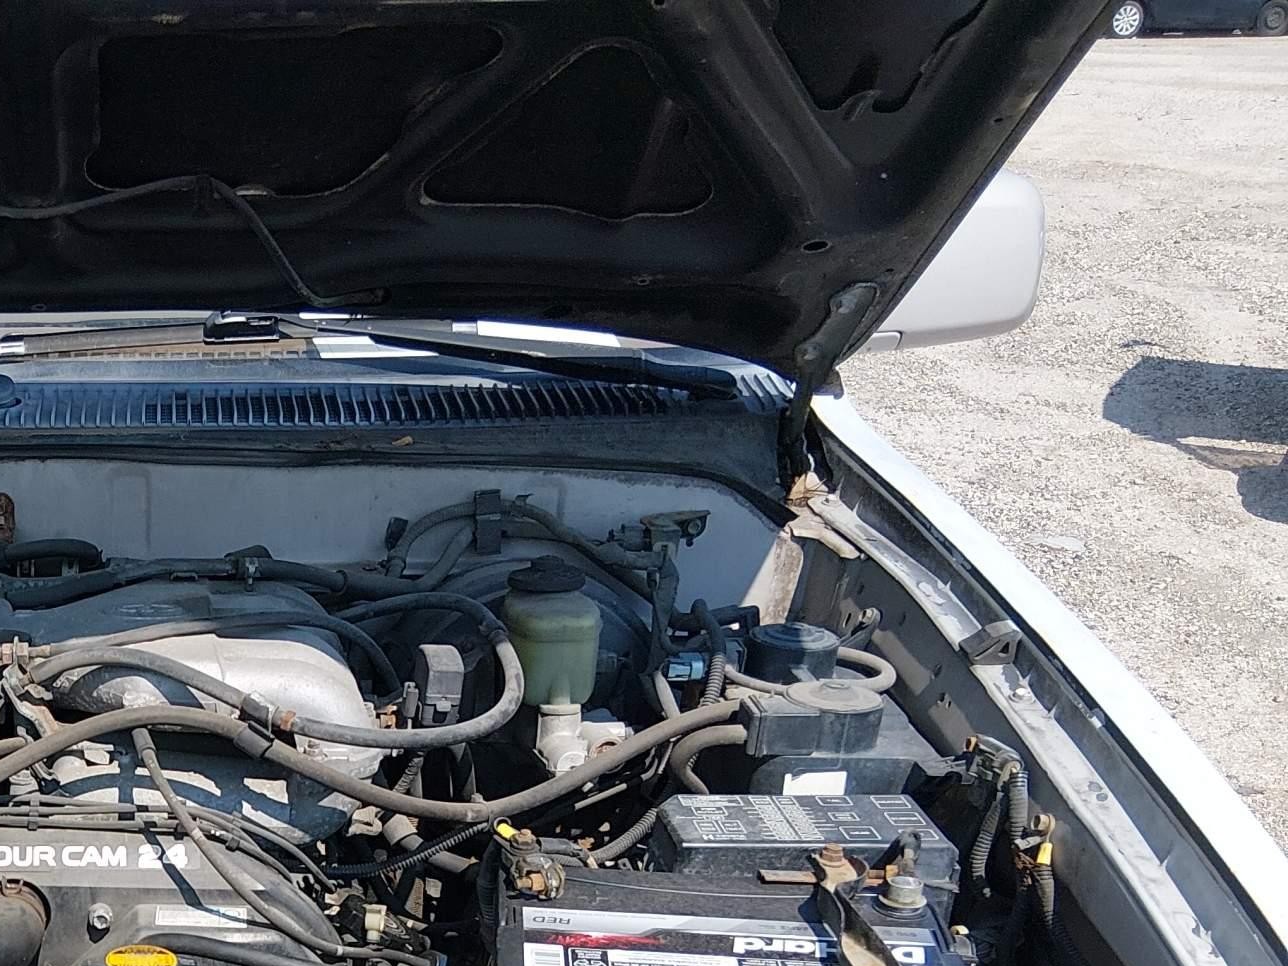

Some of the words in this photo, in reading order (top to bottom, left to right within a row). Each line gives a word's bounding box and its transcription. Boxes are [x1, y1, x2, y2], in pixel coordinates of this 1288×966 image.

[61, 845, 127, 868] CAM
[137, 843, 188, 869] 24
[532, 916, 572, 926] RED
[733, 937, 926, 965] DHard
